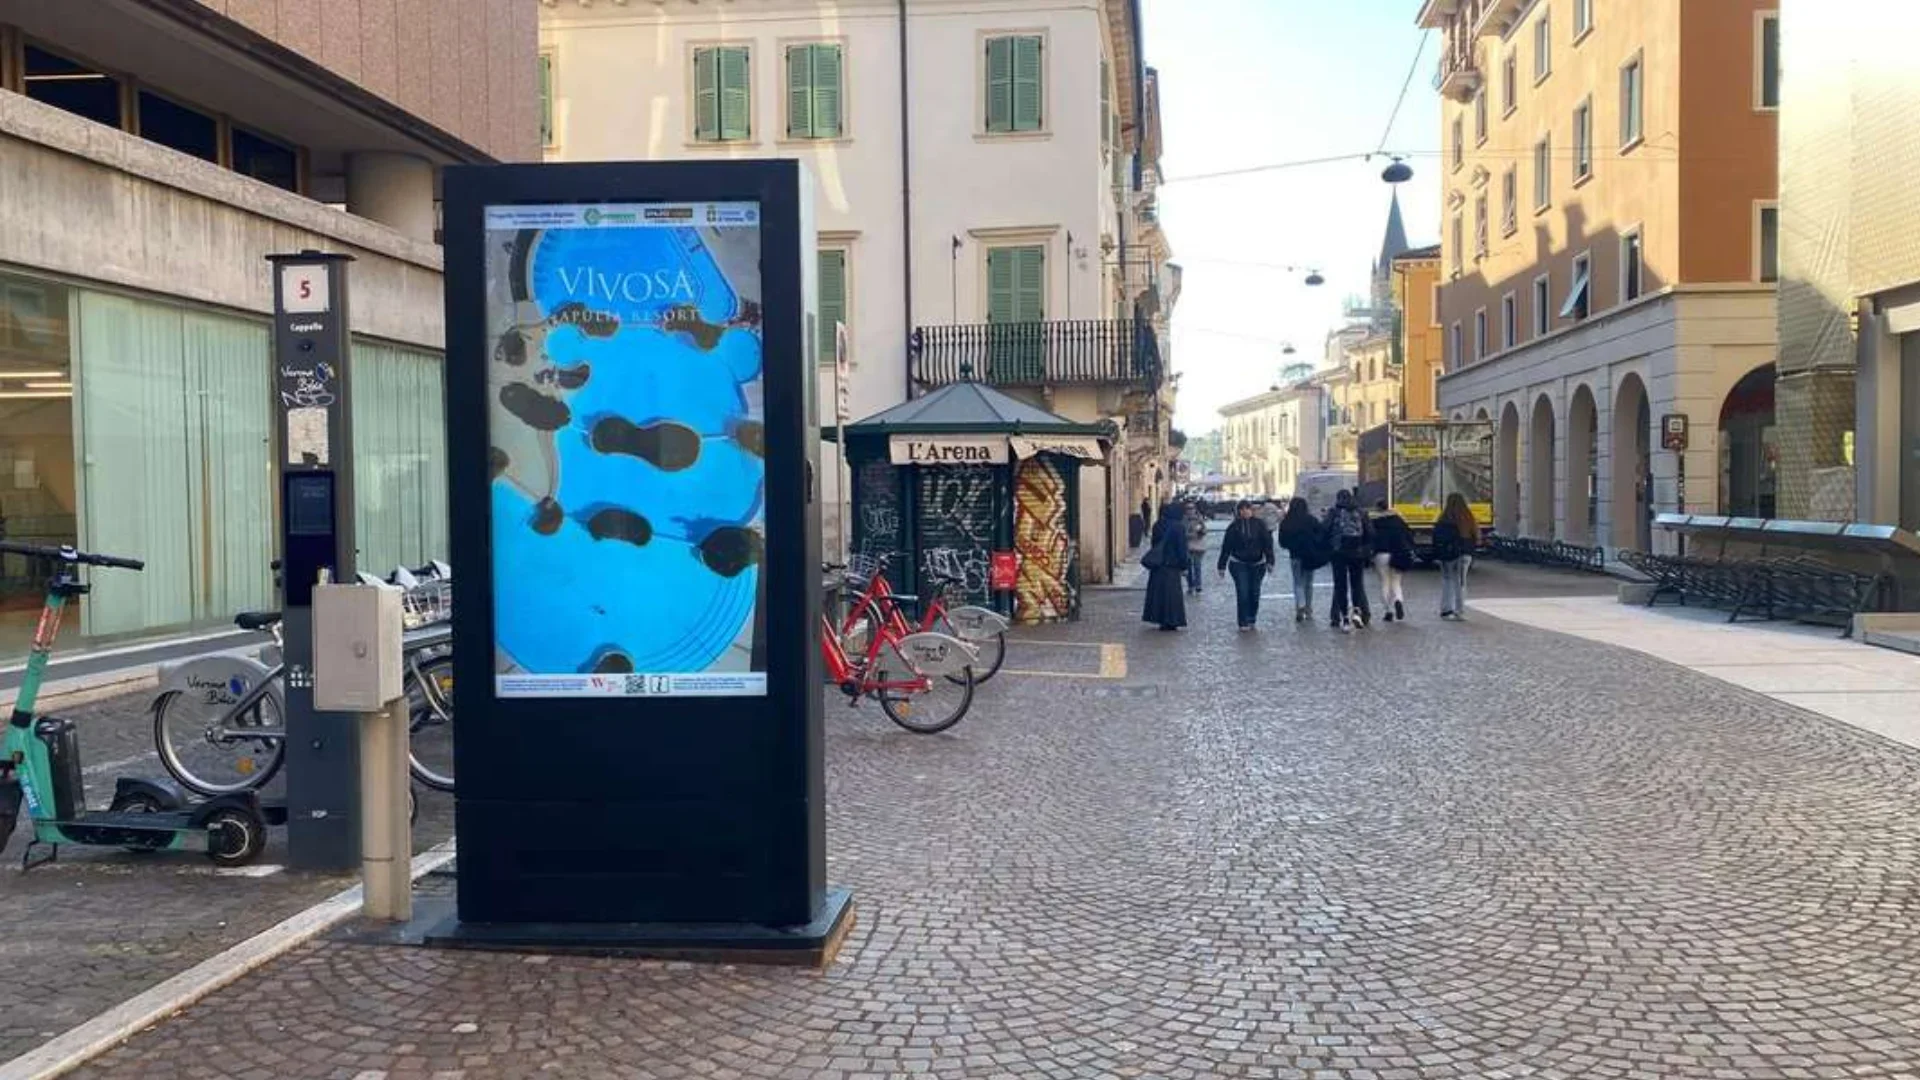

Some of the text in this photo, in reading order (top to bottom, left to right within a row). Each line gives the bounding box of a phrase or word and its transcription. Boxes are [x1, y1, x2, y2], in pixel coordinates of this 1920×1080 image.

[300, 280, 311, 299] 5
[557, 266, 694, 303] VIVOSA
[631, 308, 698, 322] RESORT
[290, 321, 323, 332] Cappello
[281, 365, 314, 378] Verona
[908, 442, 992, 461] L'Arena
[186, 676, 227, 689] Verona
